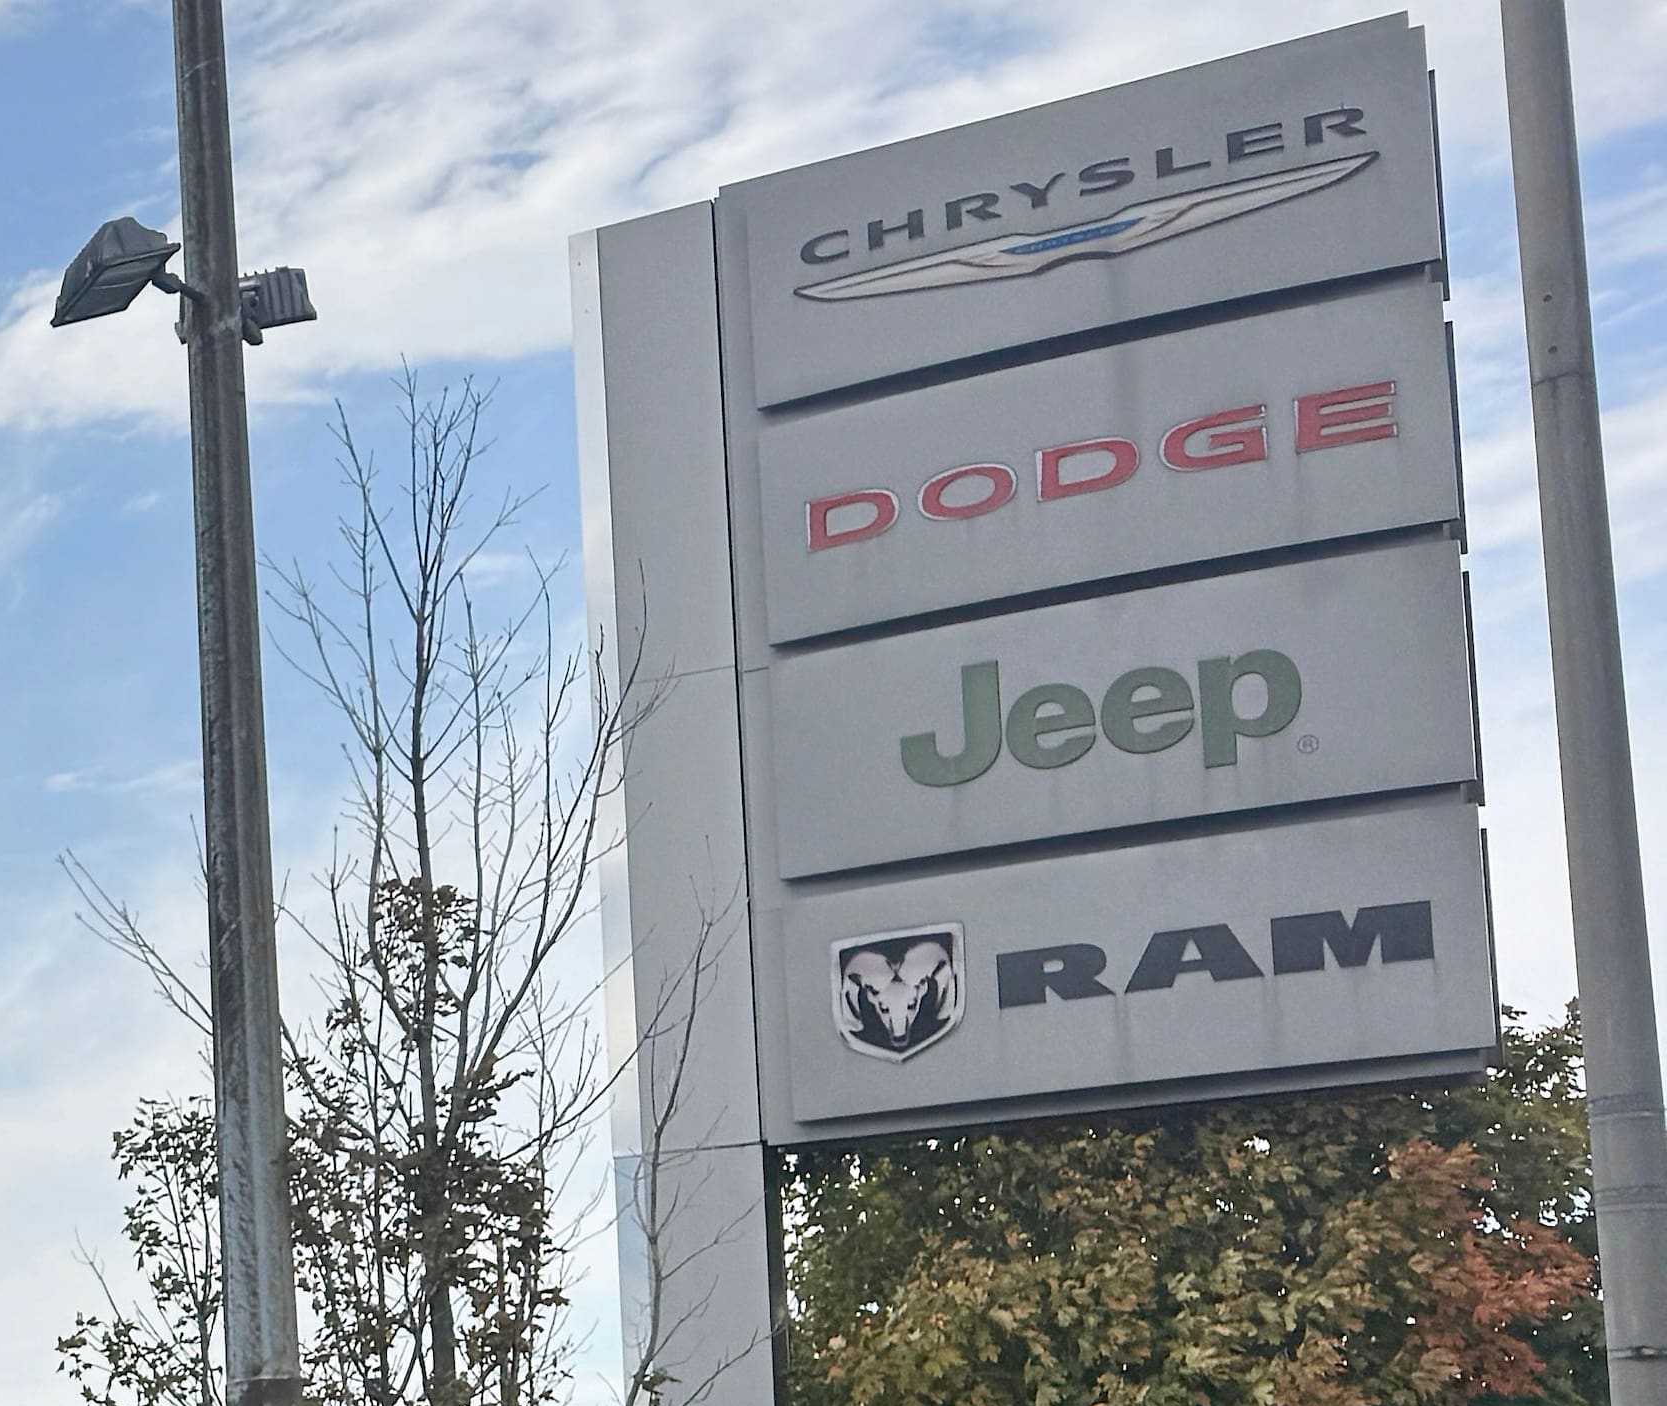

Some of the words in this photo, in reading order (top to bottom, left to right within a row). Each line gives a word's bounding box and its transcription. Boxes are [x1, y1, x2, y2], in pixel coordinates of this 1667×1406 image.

[800, 106, 1367, 266] CHRYSLER
[805, 380, 1398, 553] DODGE
[900, 648, 1303, 788] Jeep
[997, 899, 1435, 1010] RAM
